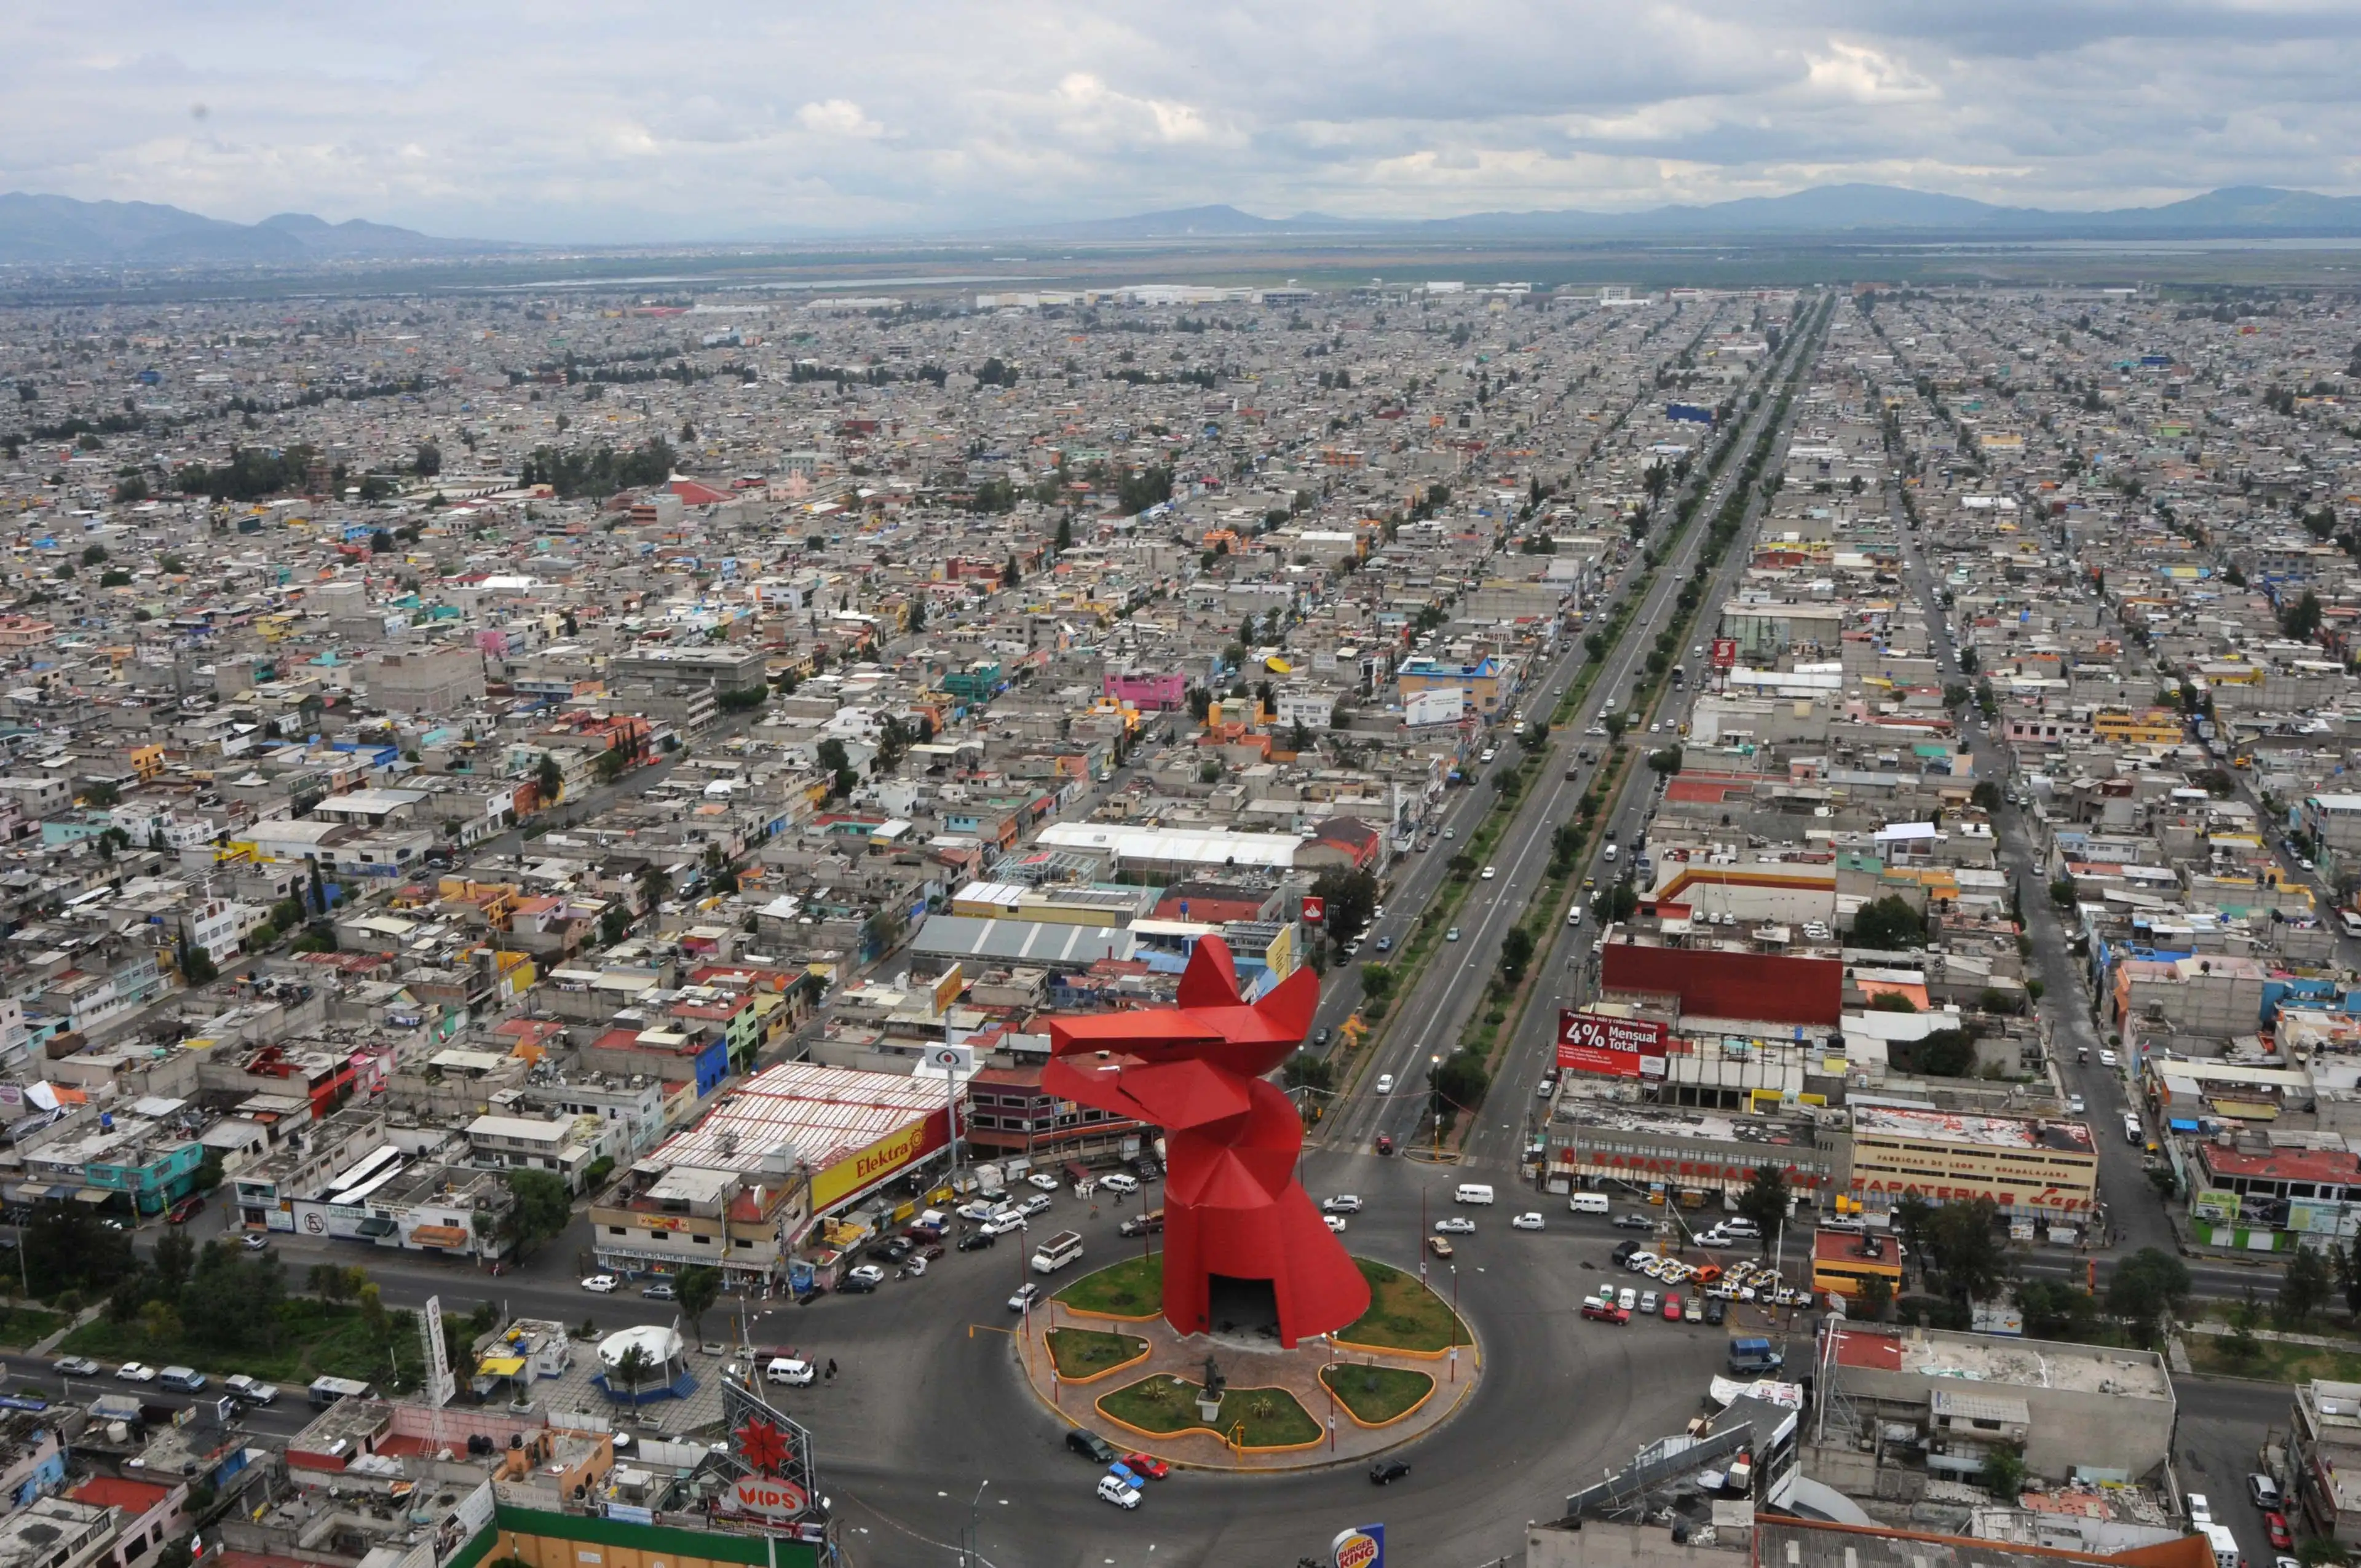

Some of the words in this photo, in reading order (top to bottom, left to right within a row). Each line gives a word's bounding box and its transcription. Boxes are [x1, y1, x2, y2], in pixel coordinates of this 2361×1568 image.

[1567, 1012, 1595, 1021] Prestamos
[1567, 1022, 1605, 1047] 4%
[1609, 1026, 1657, 1043] Mensual
[1609, 1039, 1639, 1053] Total
[856, 1142, 909, 1179] Elektra
[1877, 1155, 1925, 1165] FABRICAS
[1995, 1166, 2068, 1179] GUADALAJARA
[1851, 1178, 2015, 1206] ZAPATERIAS
[432, 1304, 448, 1379] OPTICA
[738, 1486, 797, 1510] VIPS
[1339, 1539, 1373, 1561] BURGER
[1340, 1546, 1374, 1568] KING
